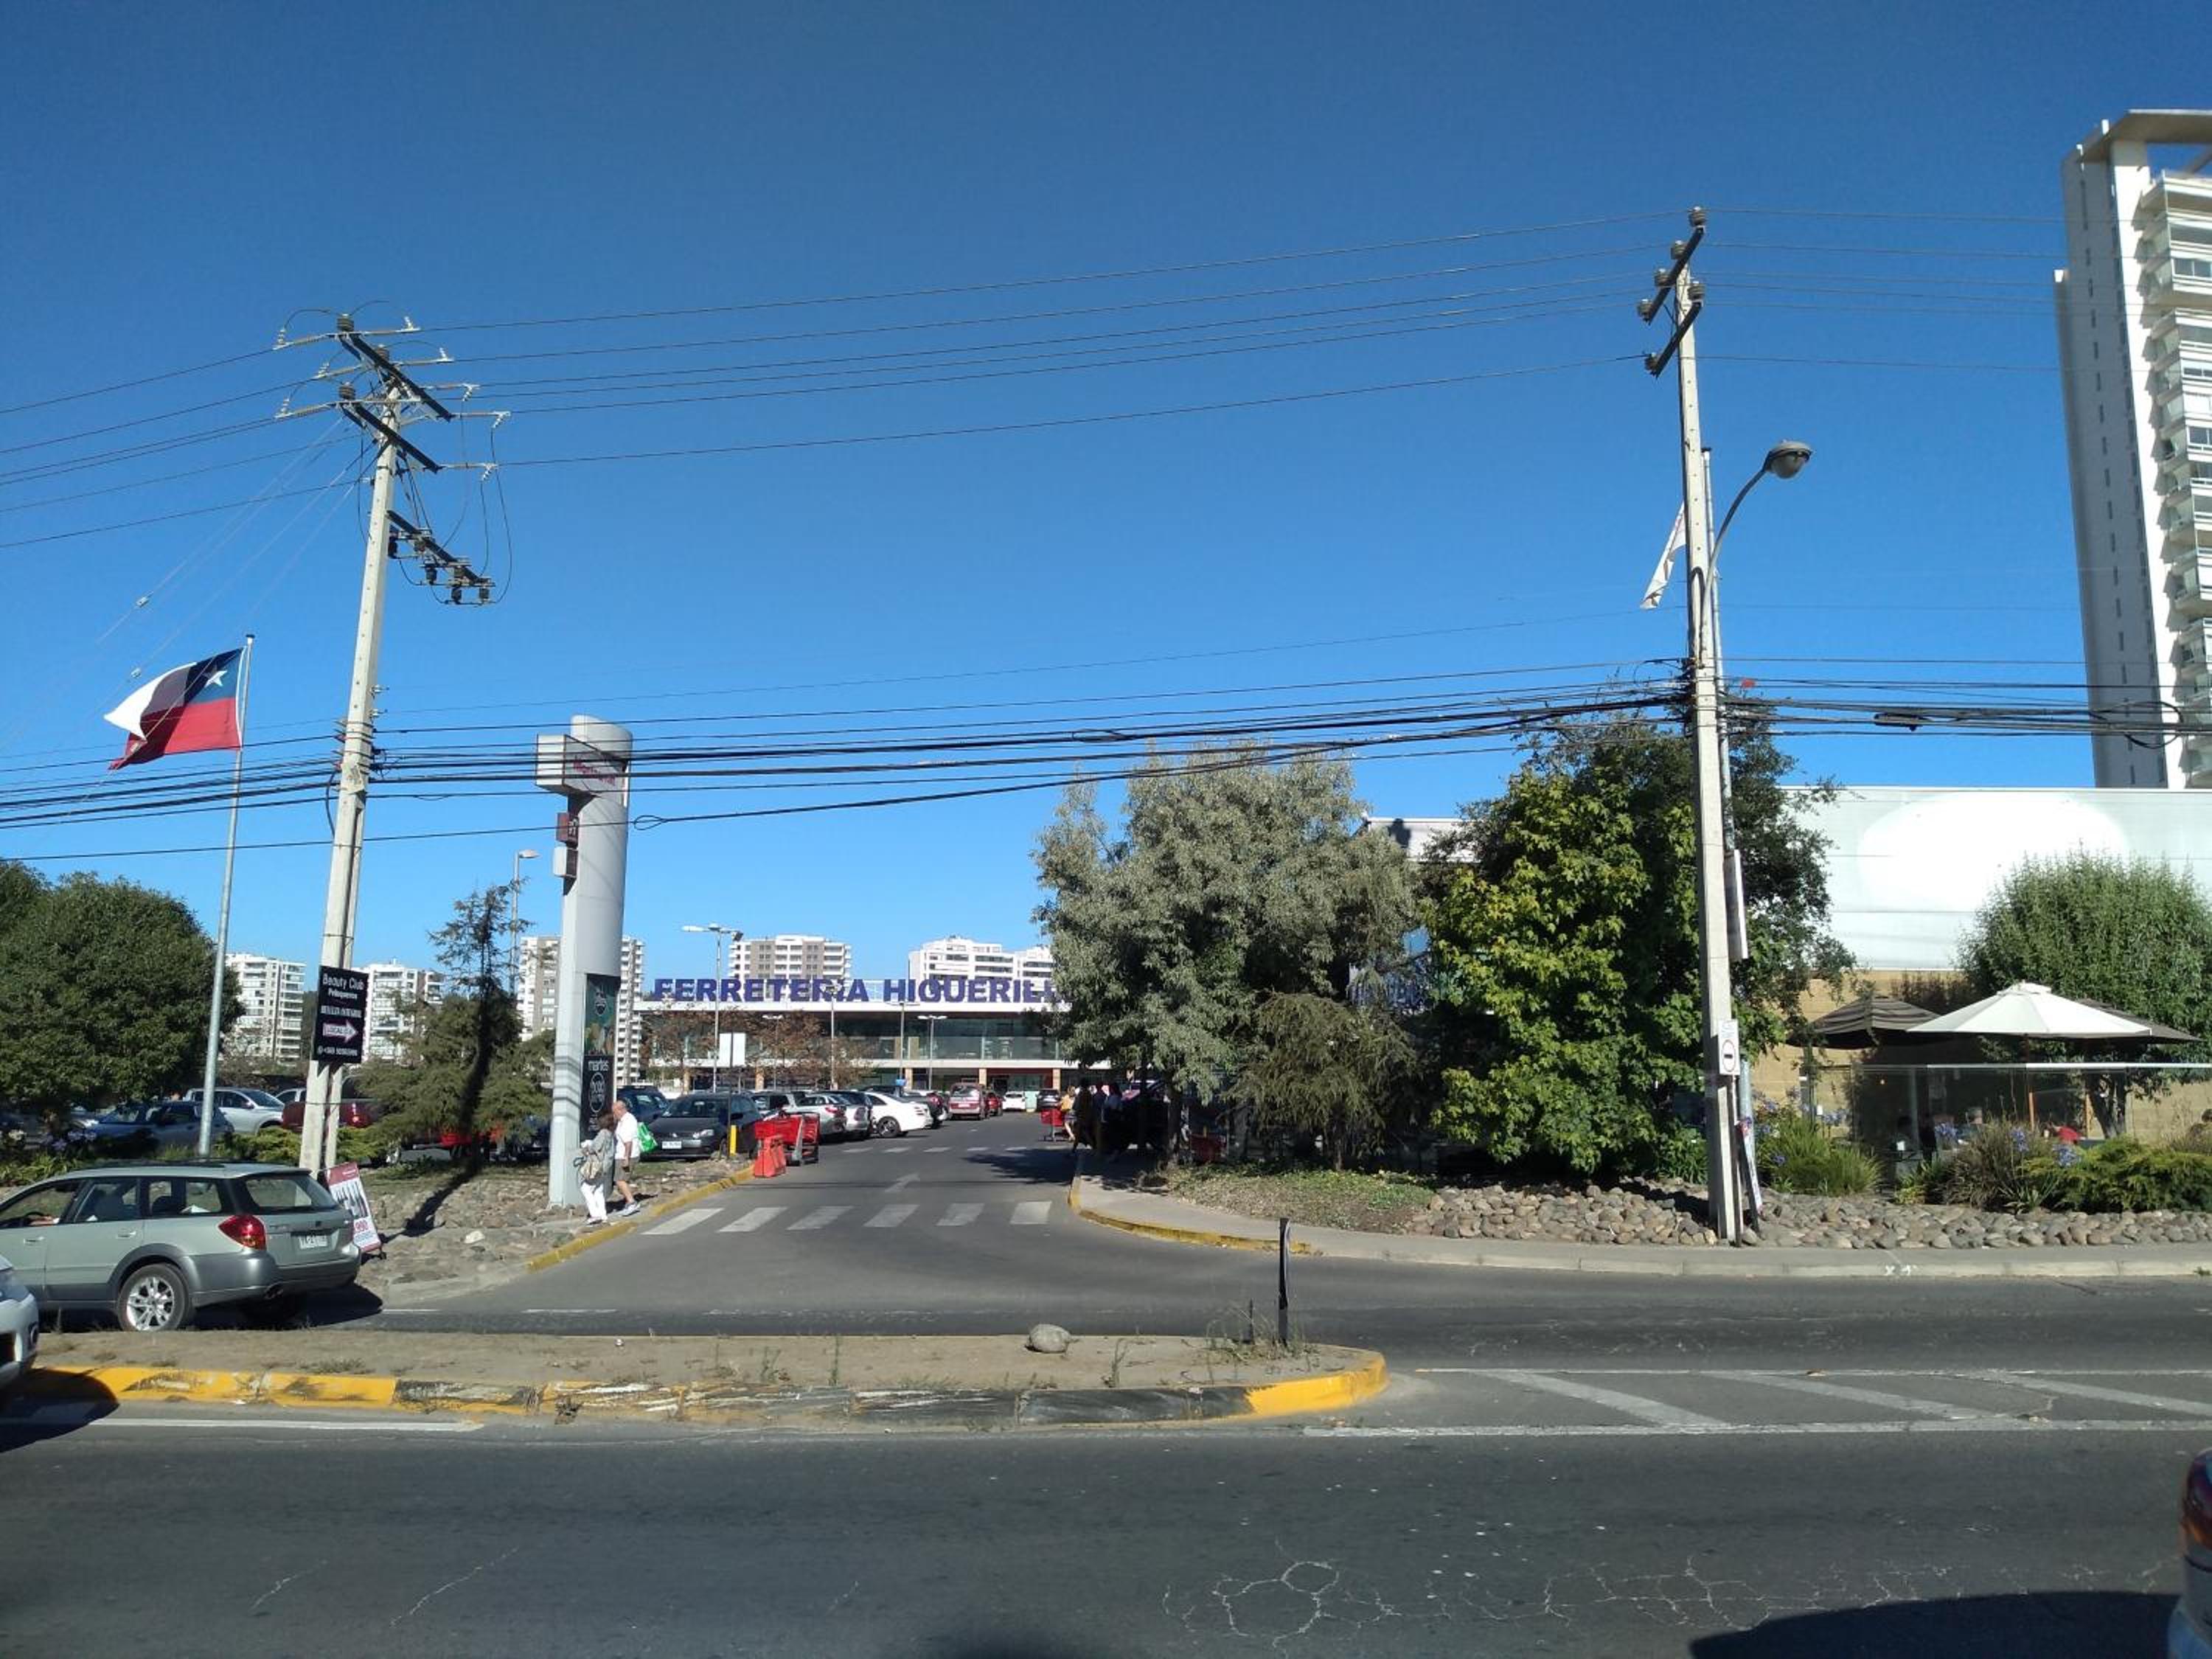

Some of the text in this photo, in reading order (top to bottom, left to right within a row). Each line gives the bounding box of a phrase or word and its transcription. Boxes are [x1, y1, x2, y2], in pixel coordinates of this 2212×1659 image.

[322, 973, 365, 990] Beauty Club
[653, 978, 870, 1002] FERRETERIA
[588, 1057, 610, 1072] martes
